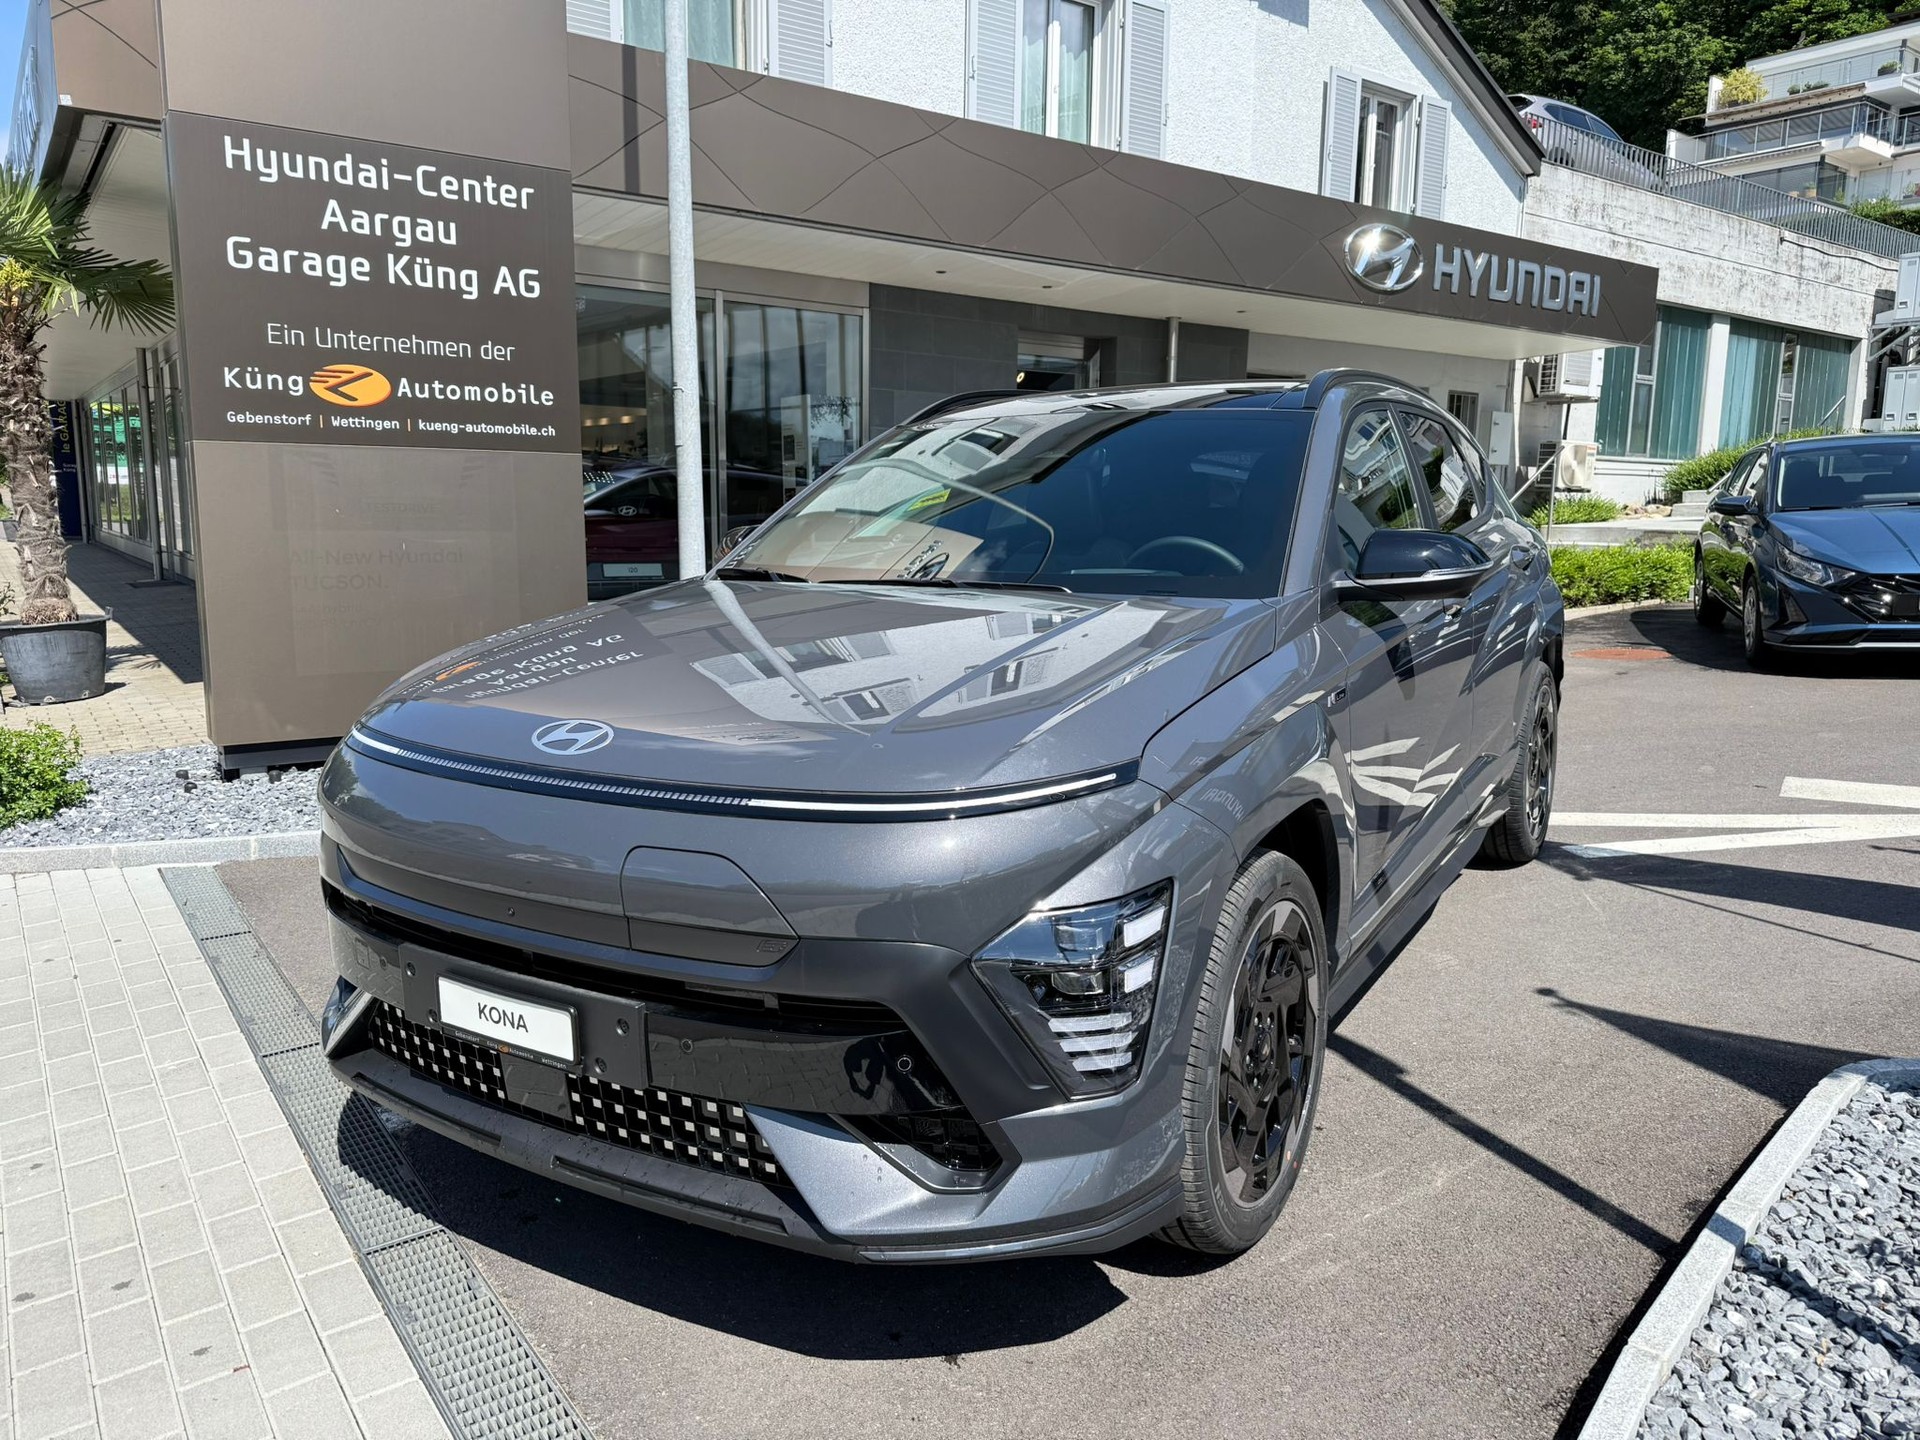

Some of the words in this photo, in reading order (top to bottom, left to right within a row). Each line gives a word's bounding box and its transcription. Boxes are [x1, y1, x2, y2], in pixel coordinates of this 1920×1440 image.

[223, 135, 535, 210] Hyundai-Center
[320, 199, 457, 247] Aargau
[226, 235, 371, 288] Garage
[388, 253, 478, 300] Küng
[493, 266, 541, 299] AG
[1432, 243, 1600, 317] HYUNDAI
[267, 323, 304, 346] Ein
[315, 326, 473, 359] Unternehmen
[480, 340, 516, 361] der
[223, 367, 304, 396] Küng
[397, 377, 555, 406] Automobile
[226, 410, 312, 426] Gebenstorf
[331, 415, 400, 431] Wettingen
[418, 419, 556, 437] kueng-automobile.ch
[477, 1002, 529, 1033] KONA
